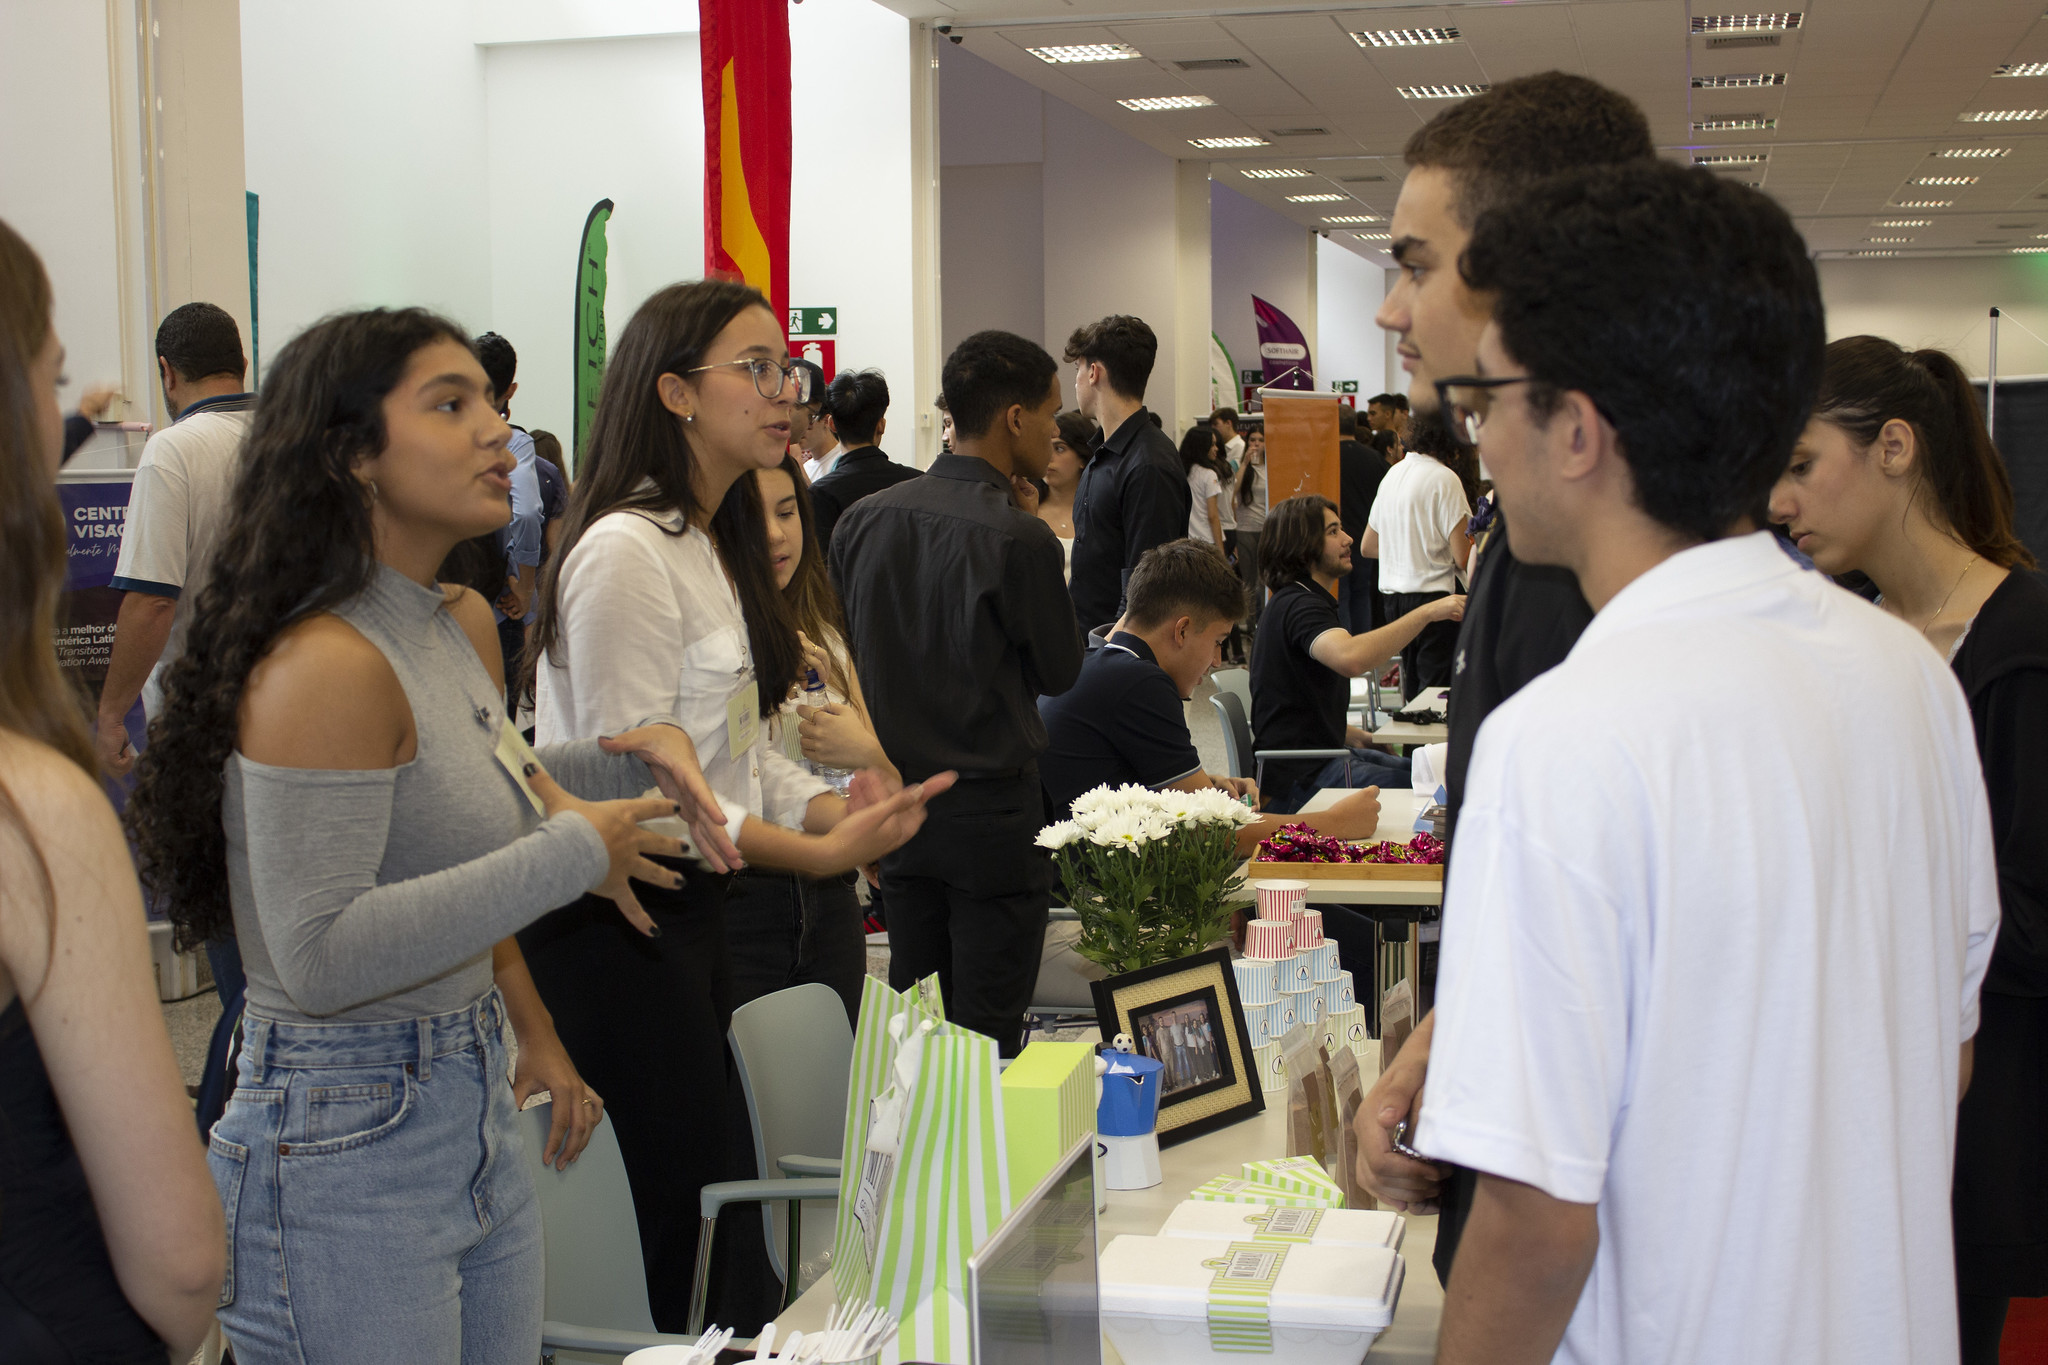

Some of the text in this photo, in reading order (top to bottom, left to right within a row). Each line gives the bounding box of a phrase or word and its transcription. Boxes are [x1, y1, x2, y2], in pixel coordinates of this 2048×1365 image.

[66, 543, 103, 557] lmente
[70, 624, 106, 635] melhor
[107, 623, 117, 633] ót
[58, 645, 110, 656] Transitions
[58, 656, 112, 667] ation Awa
